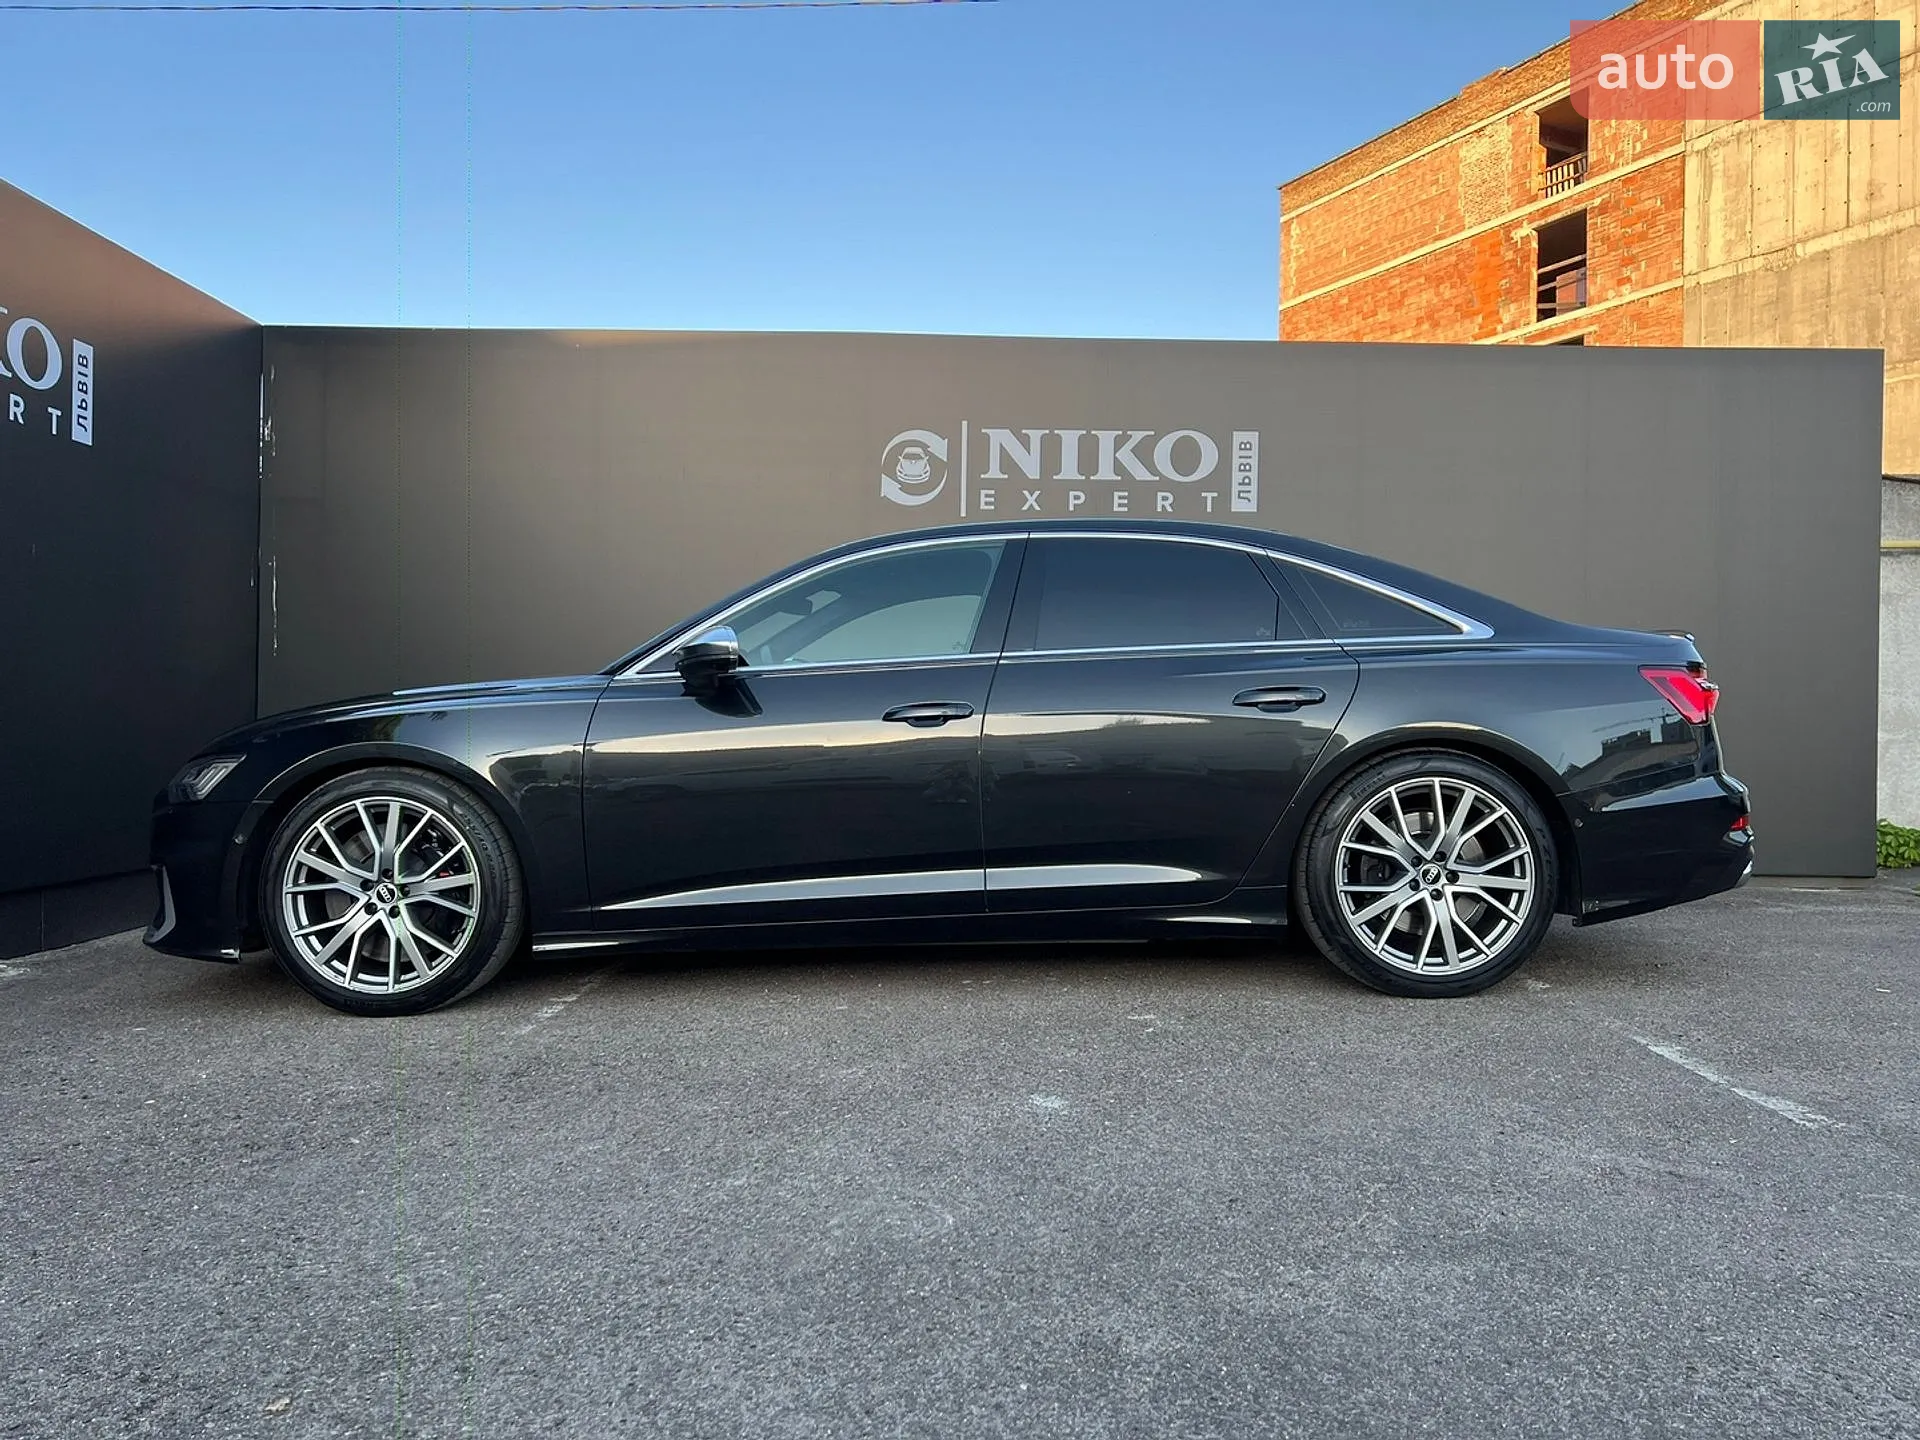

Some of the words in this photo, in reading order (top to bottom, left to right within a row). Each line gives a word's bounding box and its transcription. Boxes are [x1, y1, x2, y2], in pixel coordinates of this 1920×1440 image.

[76, 353, 89, 433] ЛЬВІВ
[980, 428, 1219, 483] NIKO
[1237, 441, 1253, 503] ЛЬВІВ
[979, 489, 1219, 512] EXPERT
